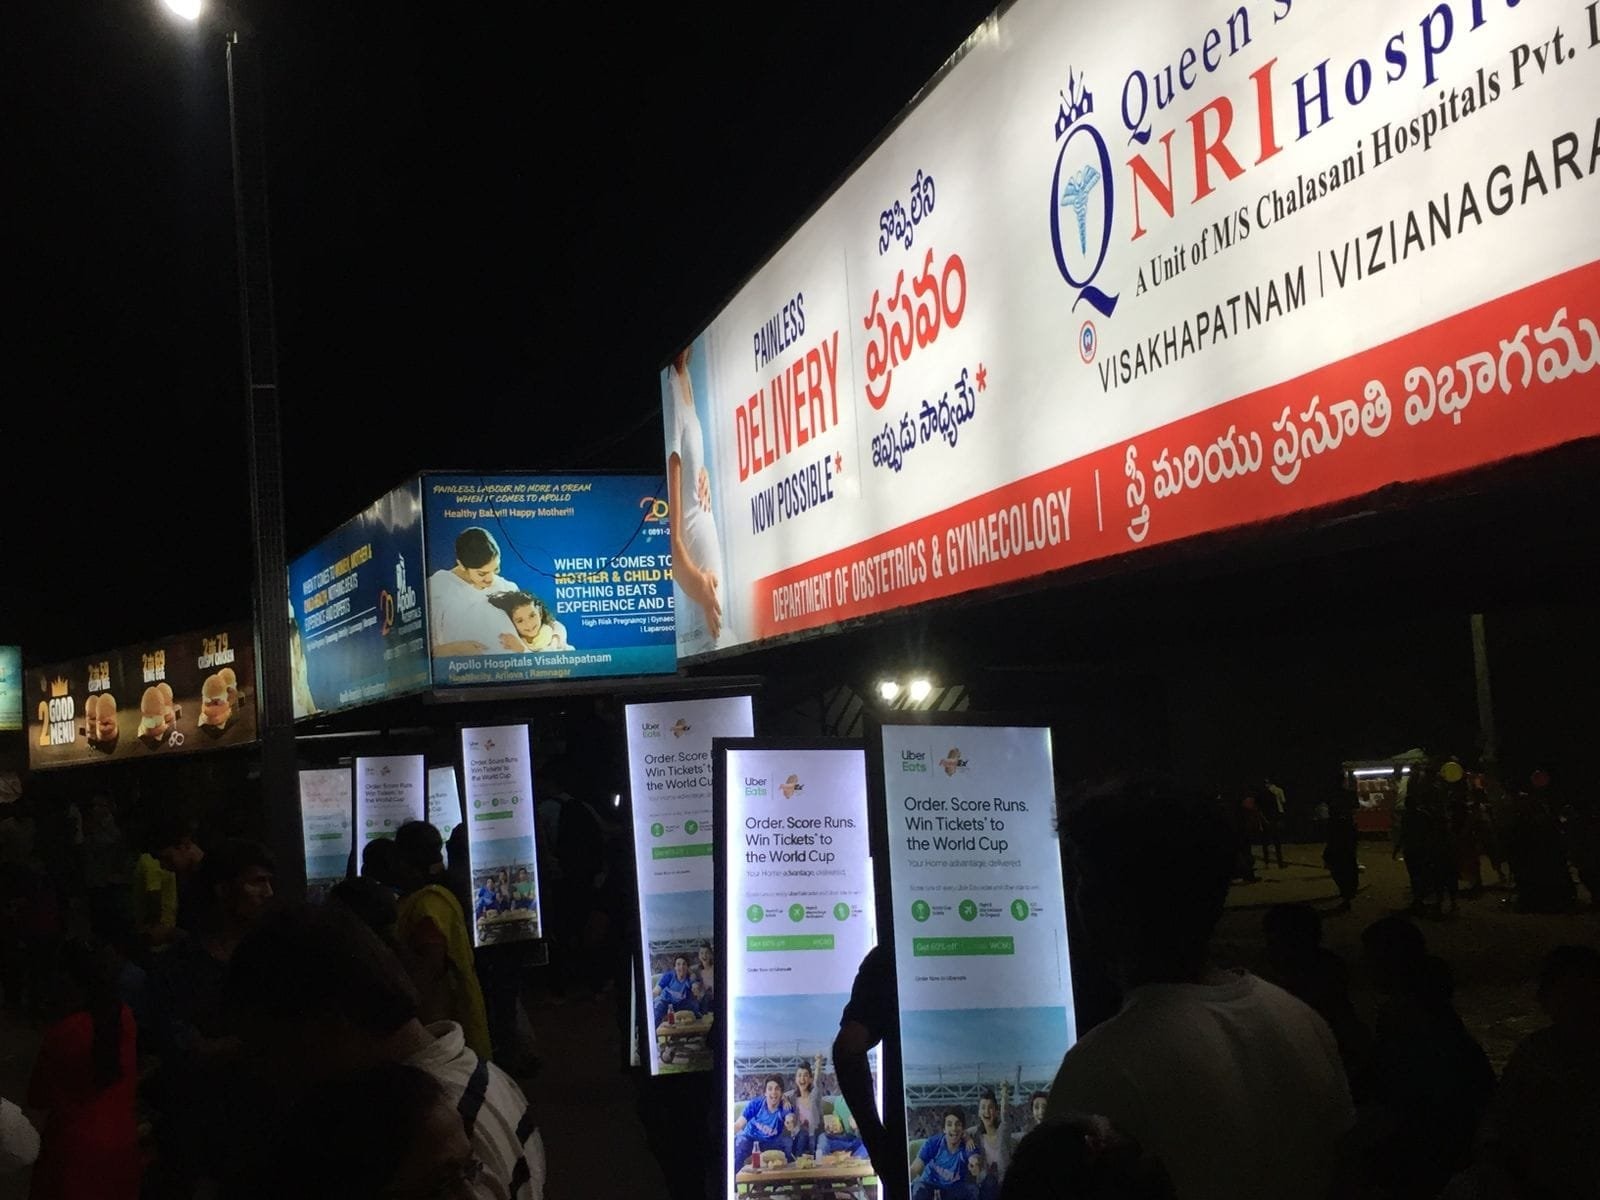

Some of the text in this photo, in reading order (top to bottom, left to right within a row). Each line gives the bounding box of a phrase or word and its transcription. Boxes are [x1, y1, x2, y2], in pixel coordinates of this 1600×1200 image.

[1125, 57, 1285, 241] NRI
[1136, 266, 1148, 298] A
[1150, 244, 1186, 289] Unit
[1191, 228, 1209, 267] of
[1212, 205, 1250, 255] M/S
[1255, 139, 1365, 230] Chalasani
[1371, 67, 1501, 168] Hospitals
[1510, 25, 1576, 90] Pvt.
[753, 291, 806, 373] PAINLESS
[863, 247, 967, 411] ప్రసవం
[1097, 265, 1307, 394] VISAKHAPATNAM
[735, 330, 840, 484] DELIVERY
[871, 415, 917, 473] ఇప్పుడు
[1123, 444, 1152, 543] స్త్రీ
[1152, 424, 1264, 501] మరియు
[1271, 378, 1393, 486] ప్రసూతి
[514, 484, 526, 493] NO
[529, 483, 551, 493] MORE
[561, 482, 592, 492] DREAM
[455, 494, 482, 503] WHEN
[495, 493, 524, 503] COMES
[524, 493, 537, 502] TO
[538, 493, 572, 502] APOLLO
[443, 508, 478, 519] Healthy
[509, 508, 537, 520] Happy
[750, 488, 777, 536] NOW
[553, 558, 593, 570] WHEN
[596, 557, 608, 569] IT
[610, 556, 656, 569] COMES
[771, 487, 1072, 624] DEPARTMENT OF OBSTETRICS & GYNAECOLOGY
[555, 572, 609, 585] MOTHER
[612, 571, 621, 583] &
[624, 569, 661, 582] CHILD
[556, 584, 657, 599] NOTHING BEATS
[557, 598, 635, 613] EXPERIENCE
[638, 597, 665, 610] AND
[581, 618, 598, 628] High
[598, 617, 613, 626] Risk
[613, 616, 647, 626] Pregnancy
[448, 653, 612, 673] Apollo Hospitals Visakhapatnam
[38, 696, 75, 746] 2 GOOD
[641, 722, 660, 731] Uber
[50, 719, 75, 746] MENU
[645, 750, 708, 765] Order. Score
[901, 749, 926, 761] Uber
[646, 766, 667, 778] Win
[902, 761, 927, 773] Eats
[646, 776, 713, 792] the World Cu
[744, 776, 768, 788] Uber
[745, 787, 768, 797] Eats
[904, 796, 1030, 812] Order. Score Runs.
[745, 815, 857, 830] Order. Score Runs.
[905, 815, 934, 831] Win
[989, 817, 1005, 831] to
[745, 833, 770, 846] Win
[820, 833, 833, 846] to
[906, 836, 1009, 854] the World Cup
[746, 849, 836, 865] the World Cup
